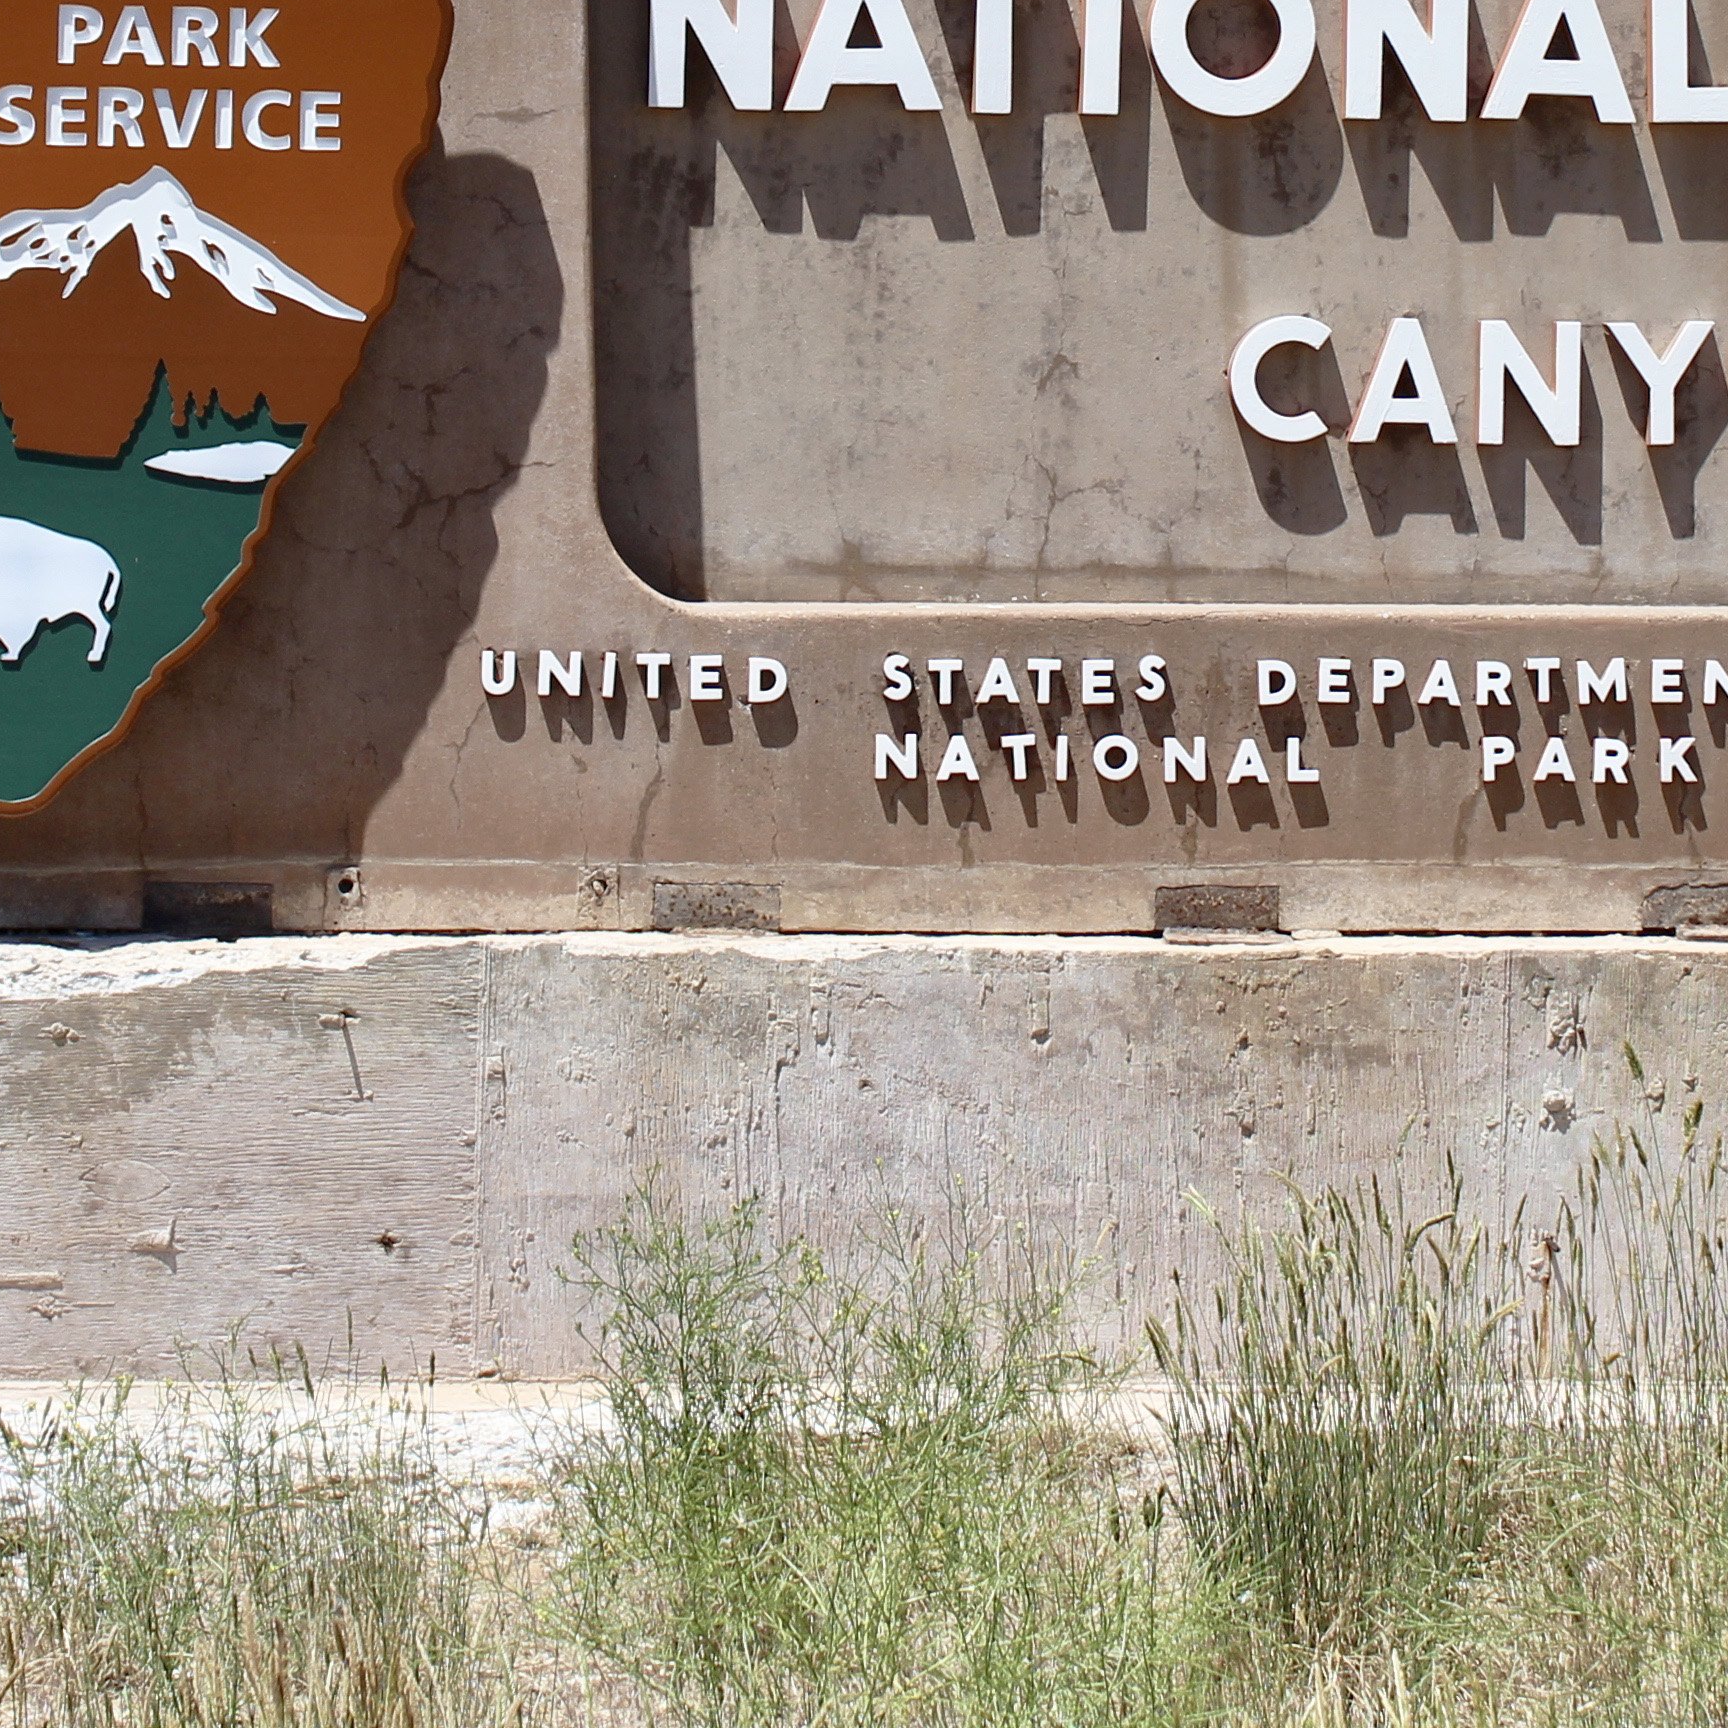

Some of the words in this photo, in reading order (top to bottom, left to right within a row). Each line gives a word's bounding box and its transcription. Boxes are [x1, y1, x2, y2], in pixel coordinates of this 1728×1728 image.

[57, 3, 281, 68] PARK
[480, 649, 789, 704] UNITED
[882, 653, 1167, 705] STATES
[873, 732, 1321, 784] NATIONAL
[1481, 735, 1699, 785] PARK
